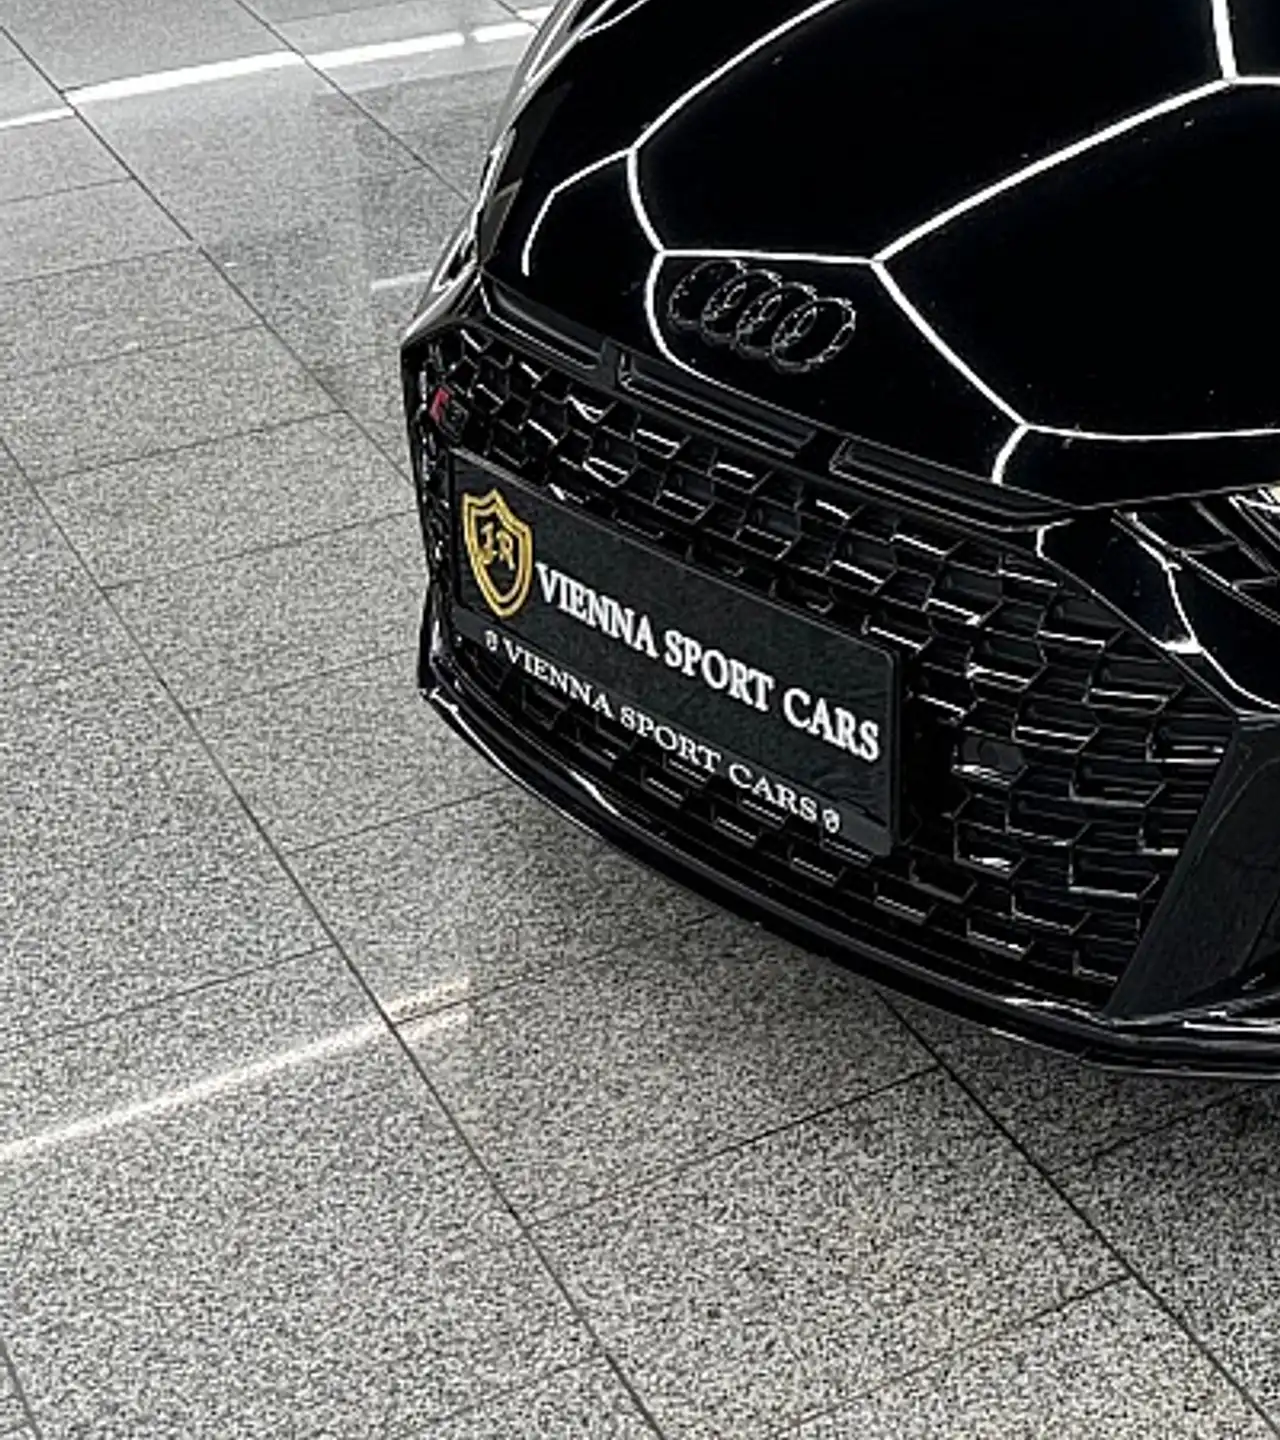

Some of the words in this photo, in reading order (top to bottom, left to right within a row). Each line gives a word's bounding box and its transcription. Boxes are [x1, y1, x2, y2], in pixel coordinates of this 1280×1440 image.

[502, 637, 616, 720] VIENNA
[620, 706, 722, 773] SPORT
[728, 762, 818, 822] CARS
[535, 562, 659, 660] VIENNA
[663, 628, 775, 712] SPORT
[782, 686, 880, 762] CARS
